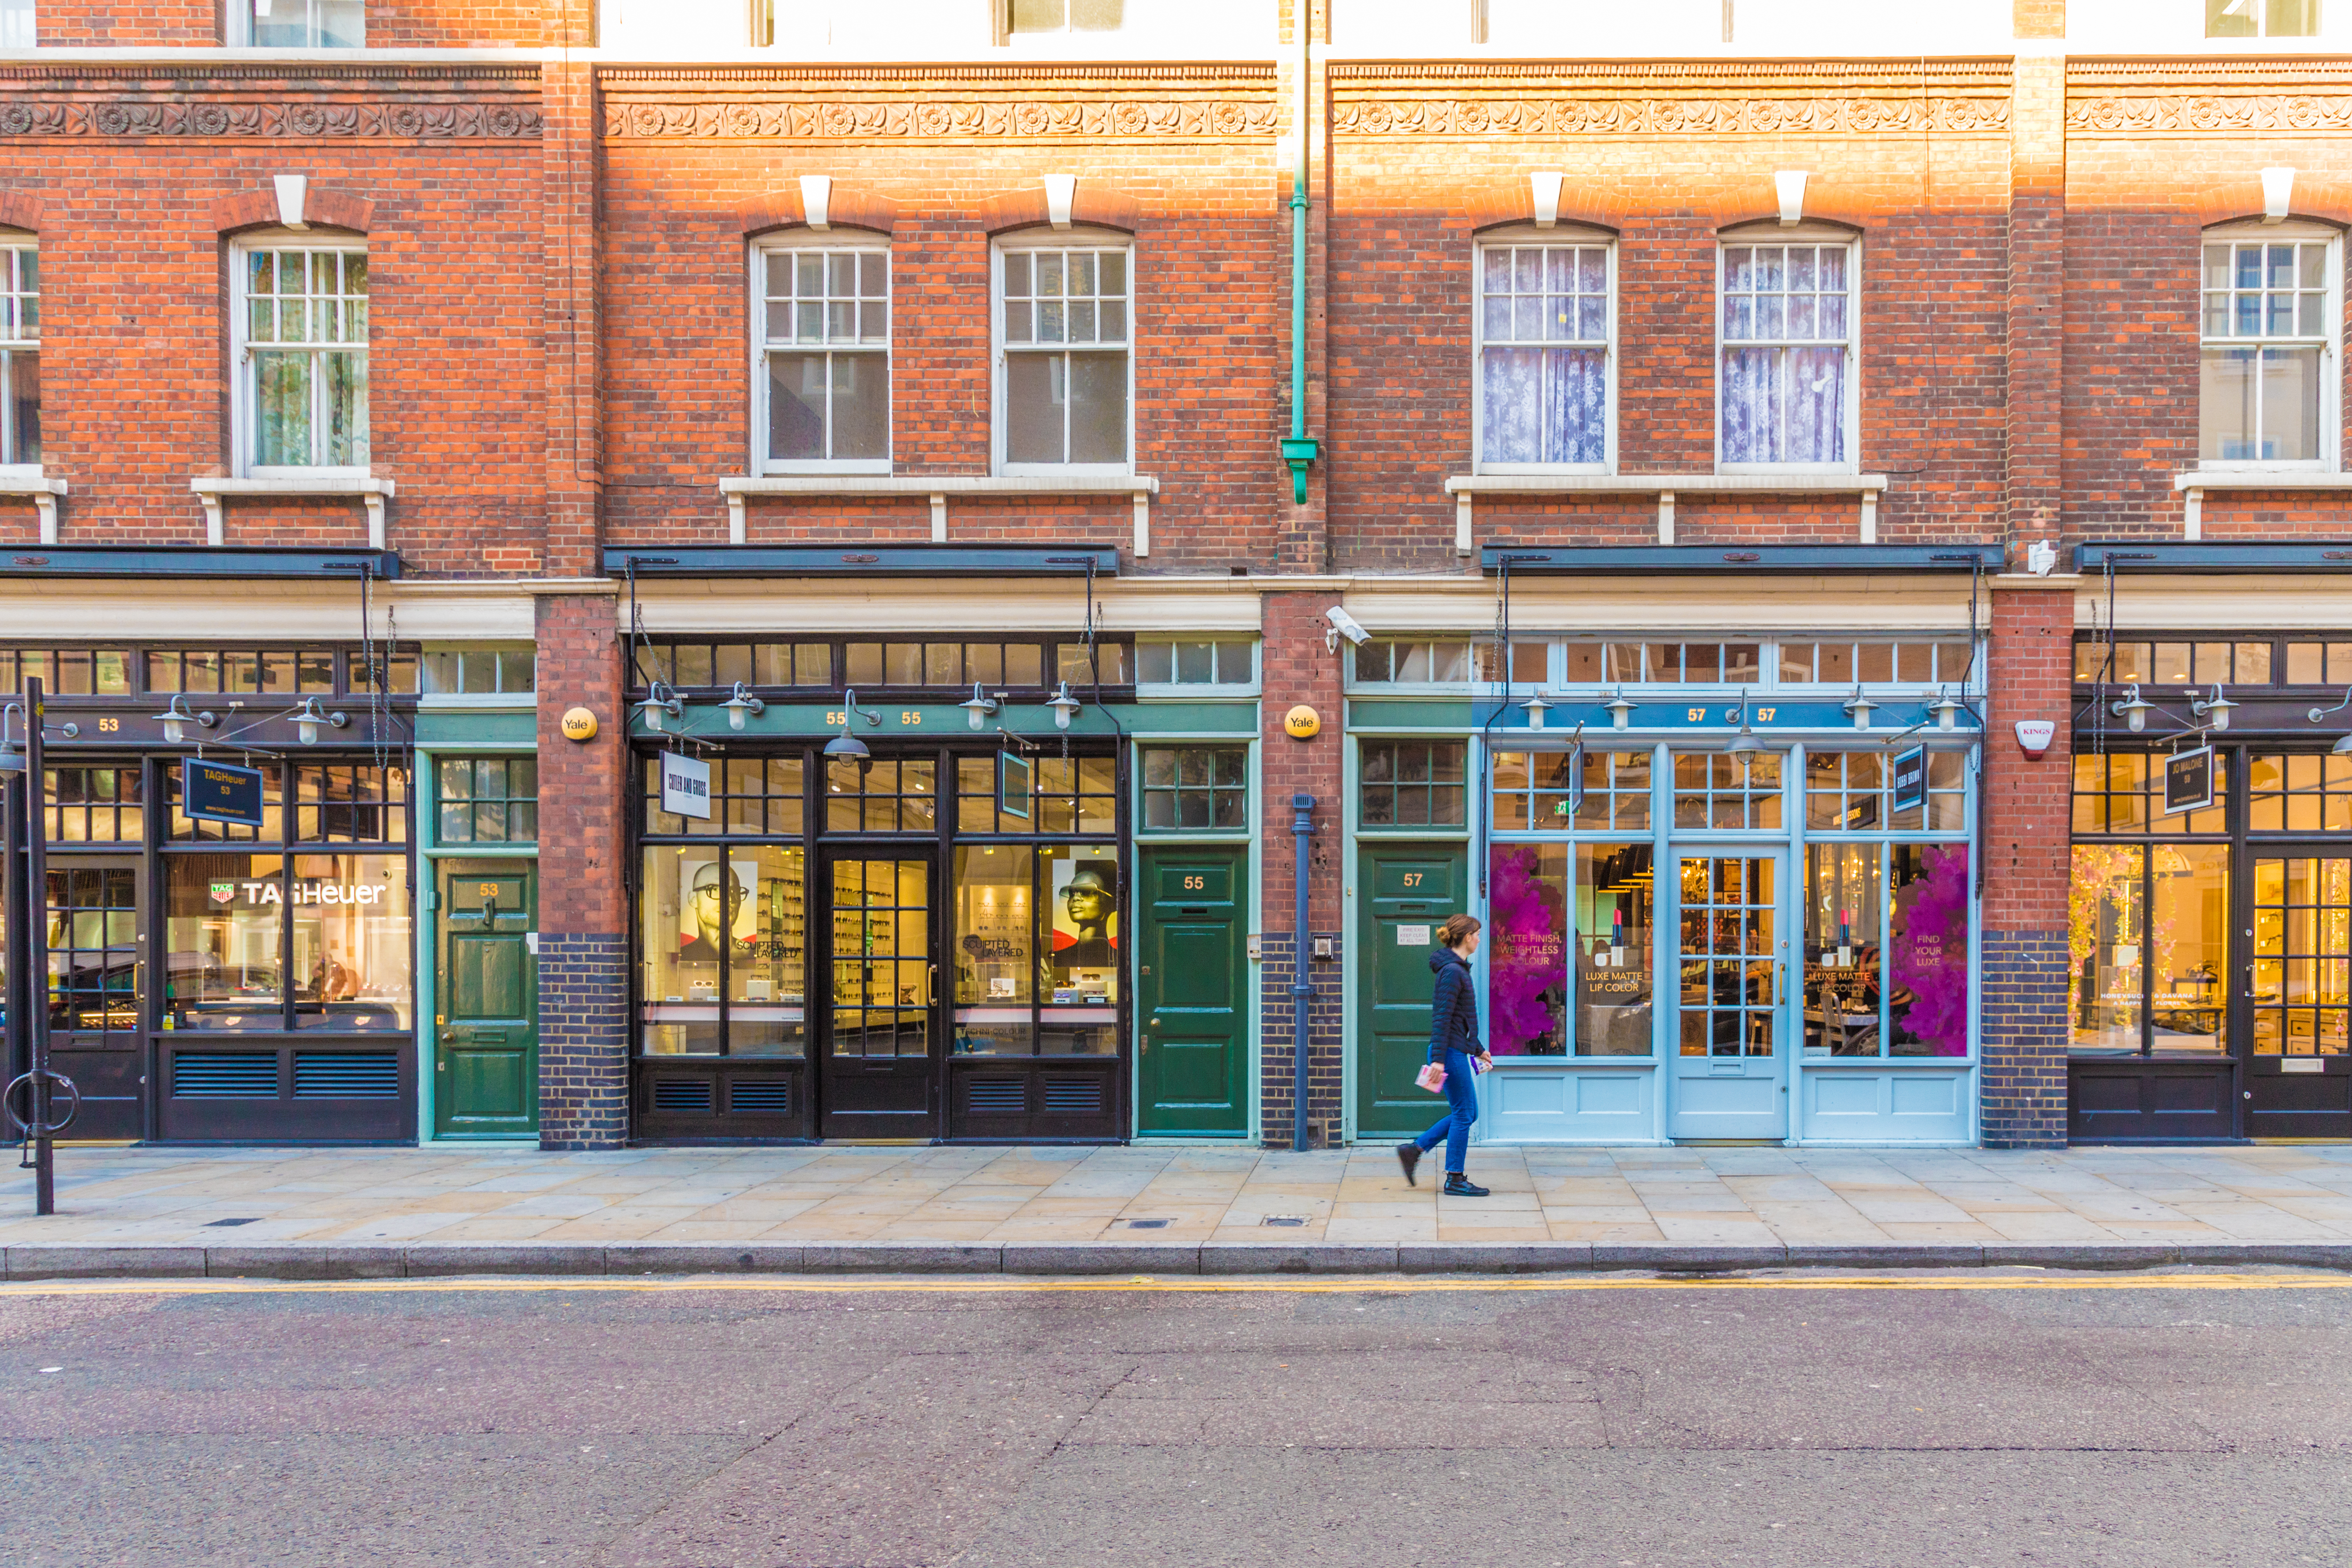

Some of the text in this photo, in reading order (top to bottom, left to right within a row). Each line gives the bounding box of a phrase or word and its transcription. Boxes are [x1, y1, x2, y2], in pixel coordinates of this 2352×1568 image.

[826, 712, 845, 724] 55
[902, 712, 921, 724] 55
[1688, 708, 1706, 721] 57
[1758, 708, 1776, 721] 57
[99, 718, 119, 731] 53
[565, 720, 588, 729] Yale
[1291, 717, 1313, 727] Yale
[2172, 756, 2203, 774] JO MALONE
[669, 773, 683, 792] CUTLER
[693, 779, 706, 797] GROSS
[221, 786, 230, 796] 53
[1184, 876, 1204, 890] 55
[1404, 873, 1423, 886] 57
[480, 883, 498, 896] 53
[213, 892, 232, 900] HEUER
[1530, 934, 1562, 944] FINISH,
[1917, 935, 1939, 943] FIND
[1501, 946, 1558, 954] WEIGHTLESS
[1915, 947, 1941, 955] YOUR
[1917, 958, 1940, 966] LUXE
[1586, 972, 1642, 980] LUXE MATTE
[1813, 972, 1870, 981] LUXE MATTE
[1605, 983, 1638, 992] COLOR
[1833, 984, 1866, 992] COLOR
